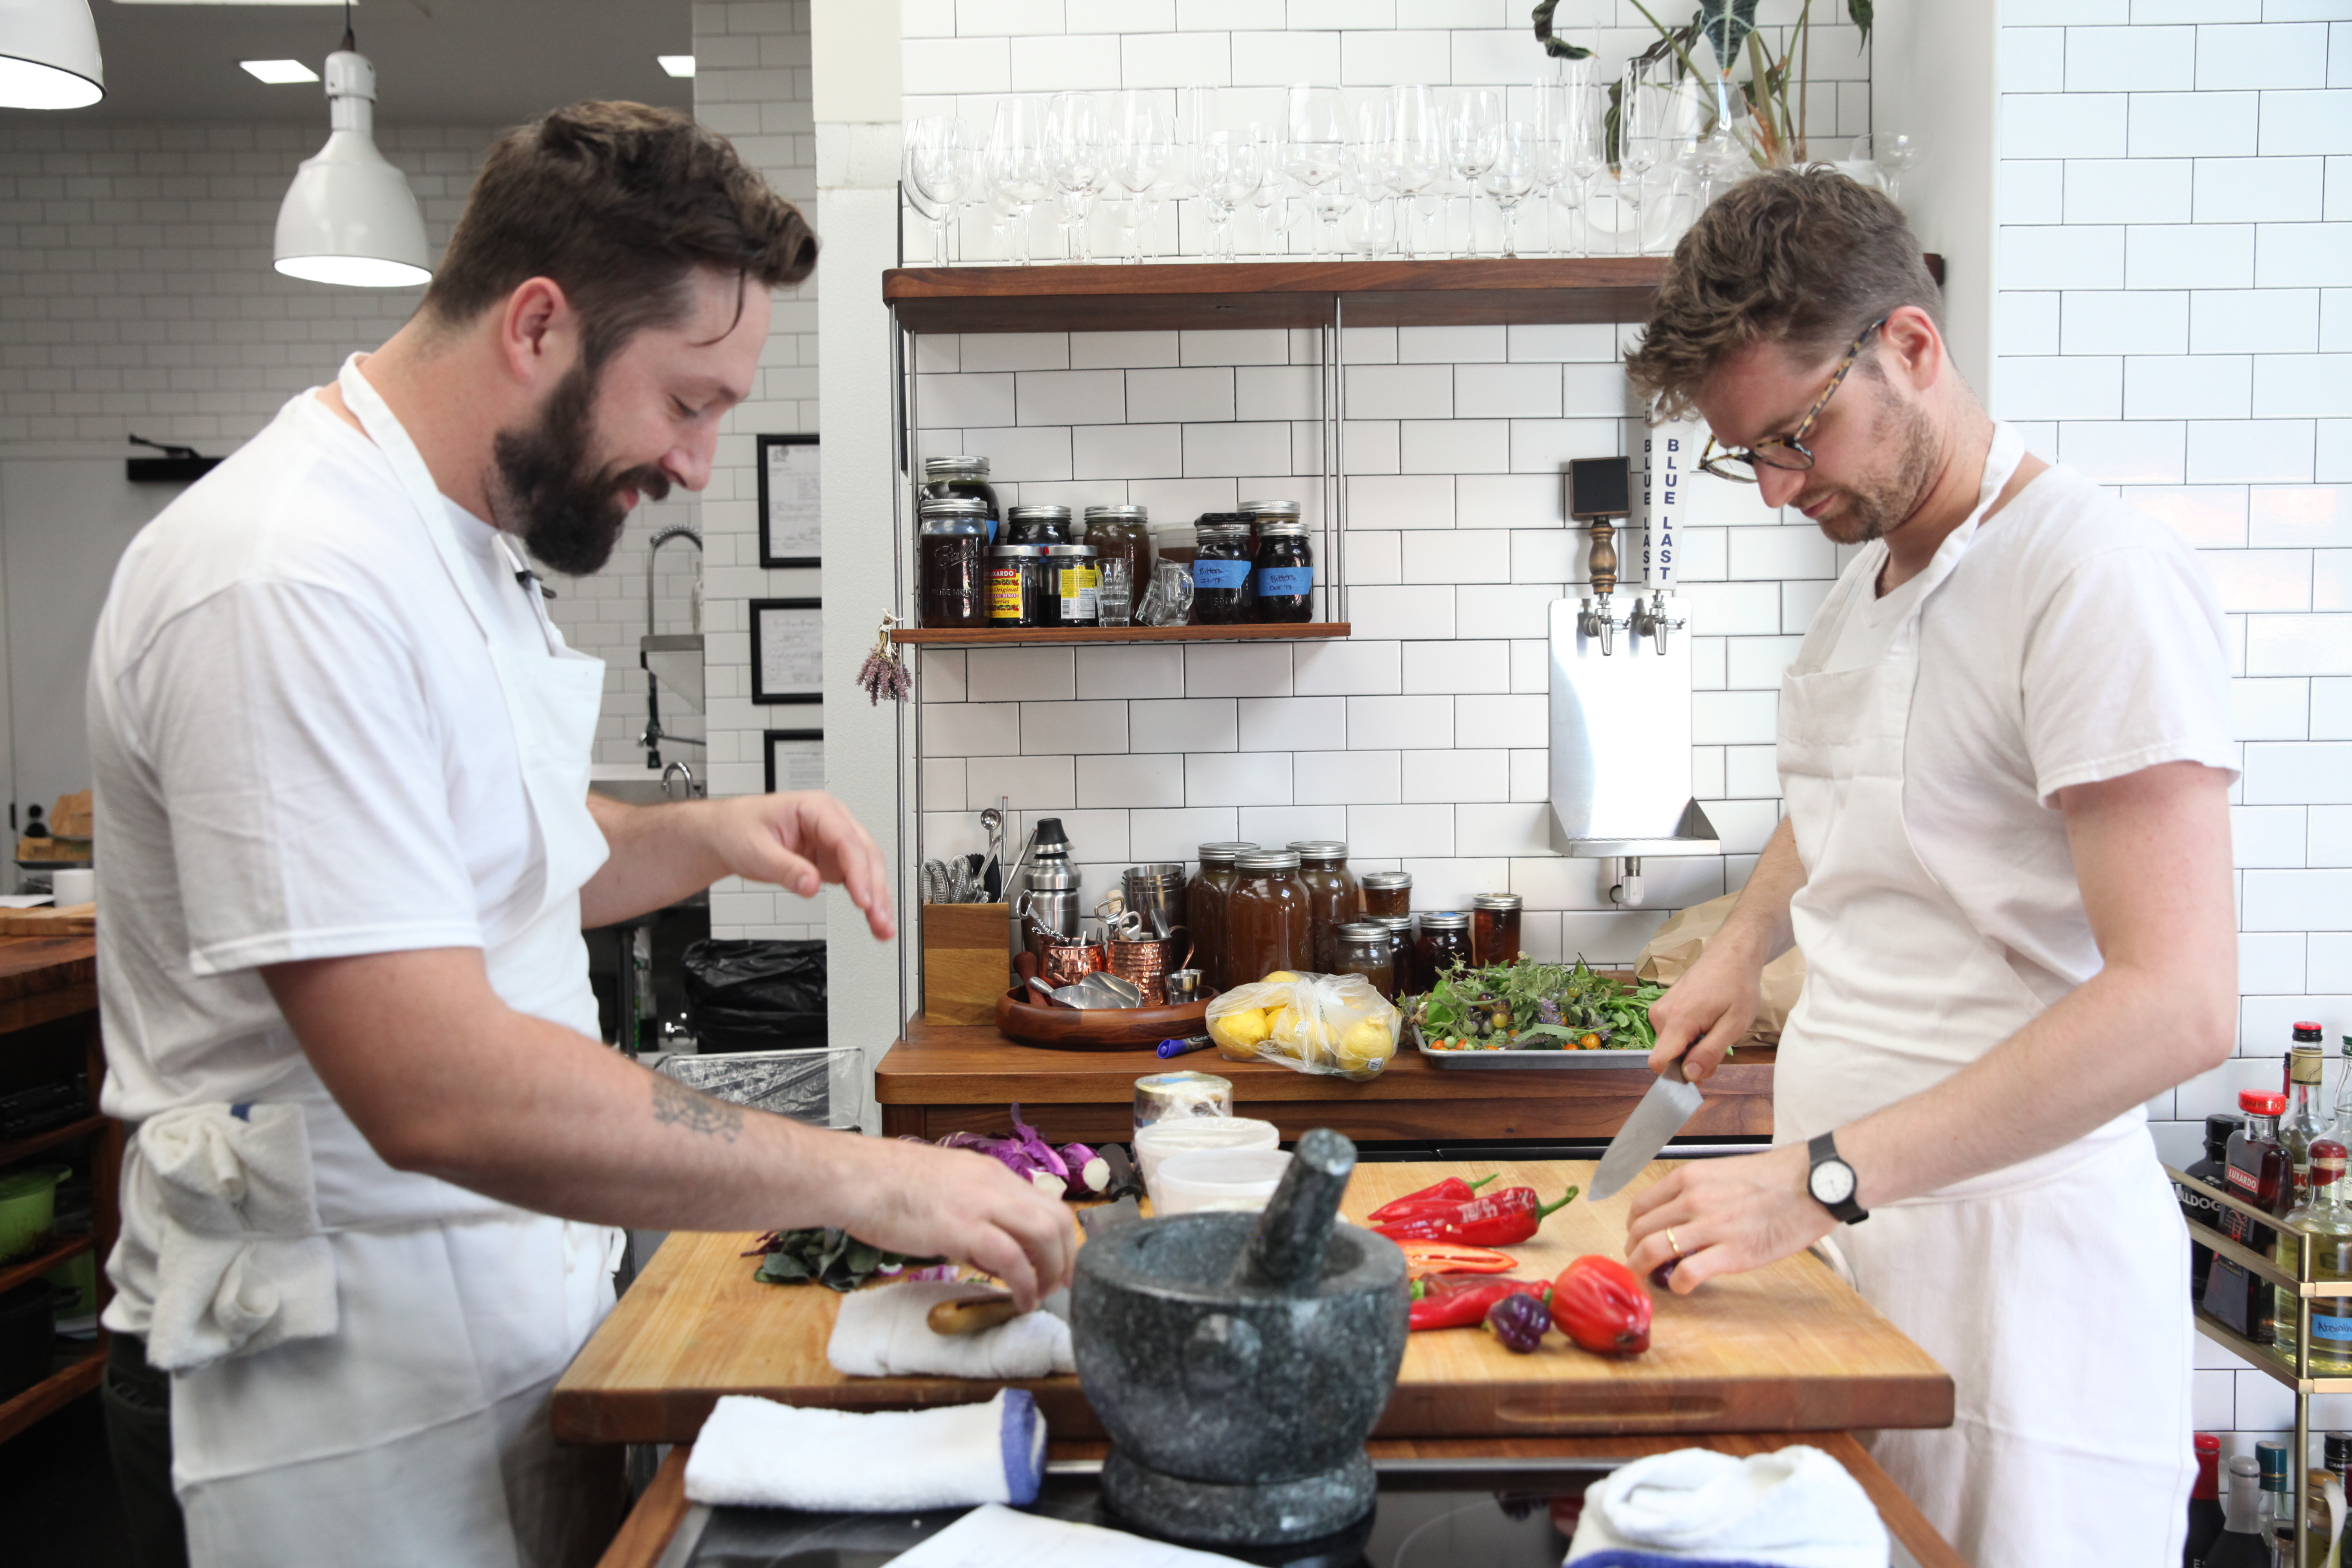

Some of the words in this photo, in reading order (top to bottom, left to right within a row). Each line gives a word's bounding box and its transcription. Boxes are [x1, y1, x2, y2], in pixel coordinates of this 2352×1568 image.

[1663, 439, 1679, 505] BLUE
[934, 544, 978, 567] Ball
[1659, 516, 1673, 580] LAST
[1271, 574, 1296, 583] Bitters
[2229, 1169, 2257, 1189] LUXARDO
